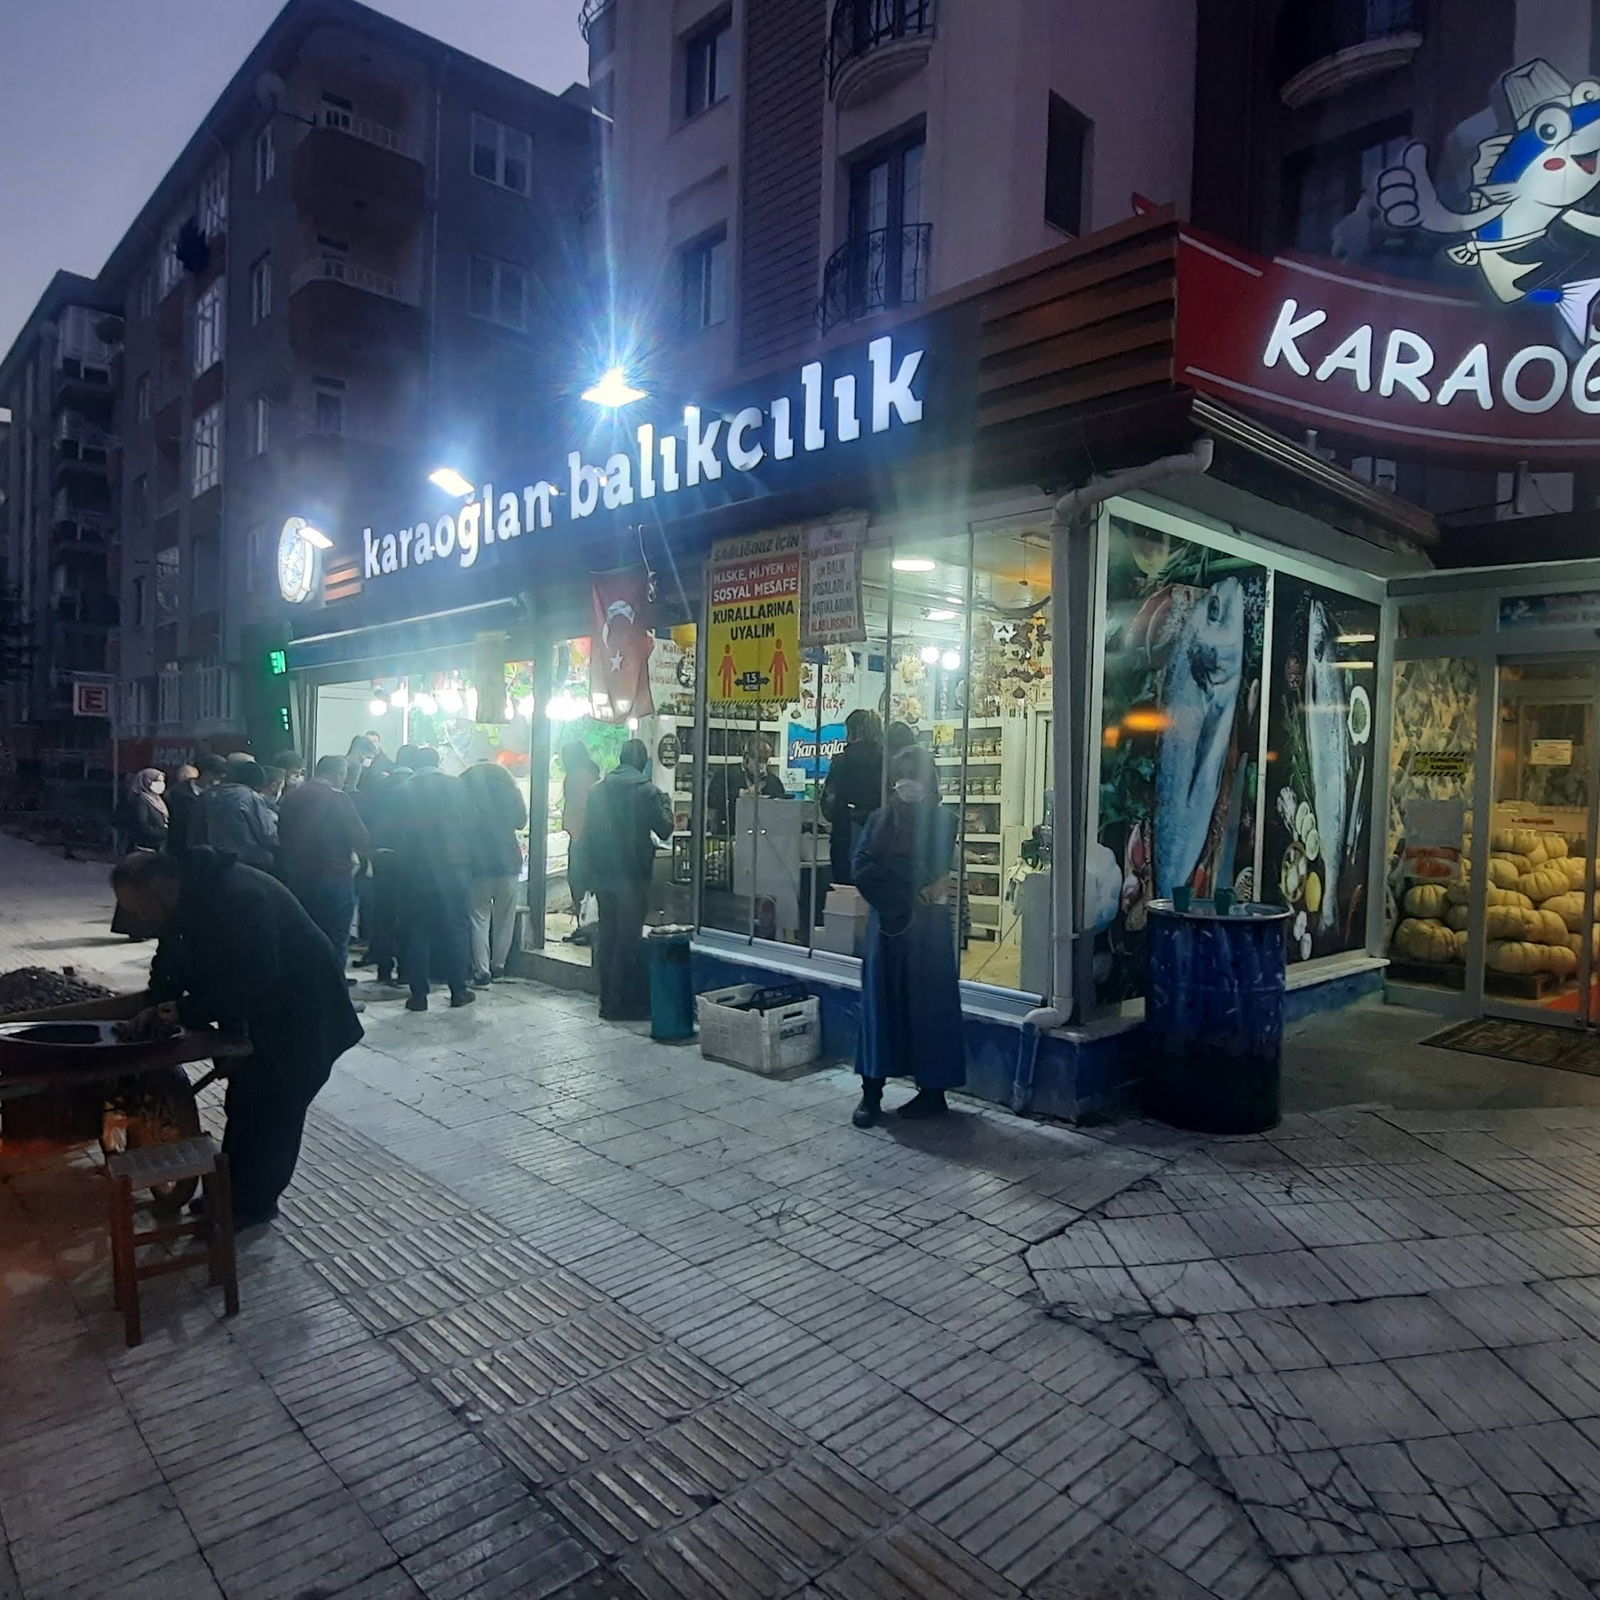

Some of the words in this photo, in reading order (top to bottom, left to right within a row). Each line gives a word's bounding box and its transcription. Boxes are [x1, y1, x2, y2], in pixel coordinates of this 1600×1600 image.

[713, 584, 751, 602] SOSYAL
[754, 577, 798, 597] MESAFE
[712, 600, 795, 624] KURALLARINA
[730, 623, 775, 641] UYALIM
[85, 690, 103, 708] E
